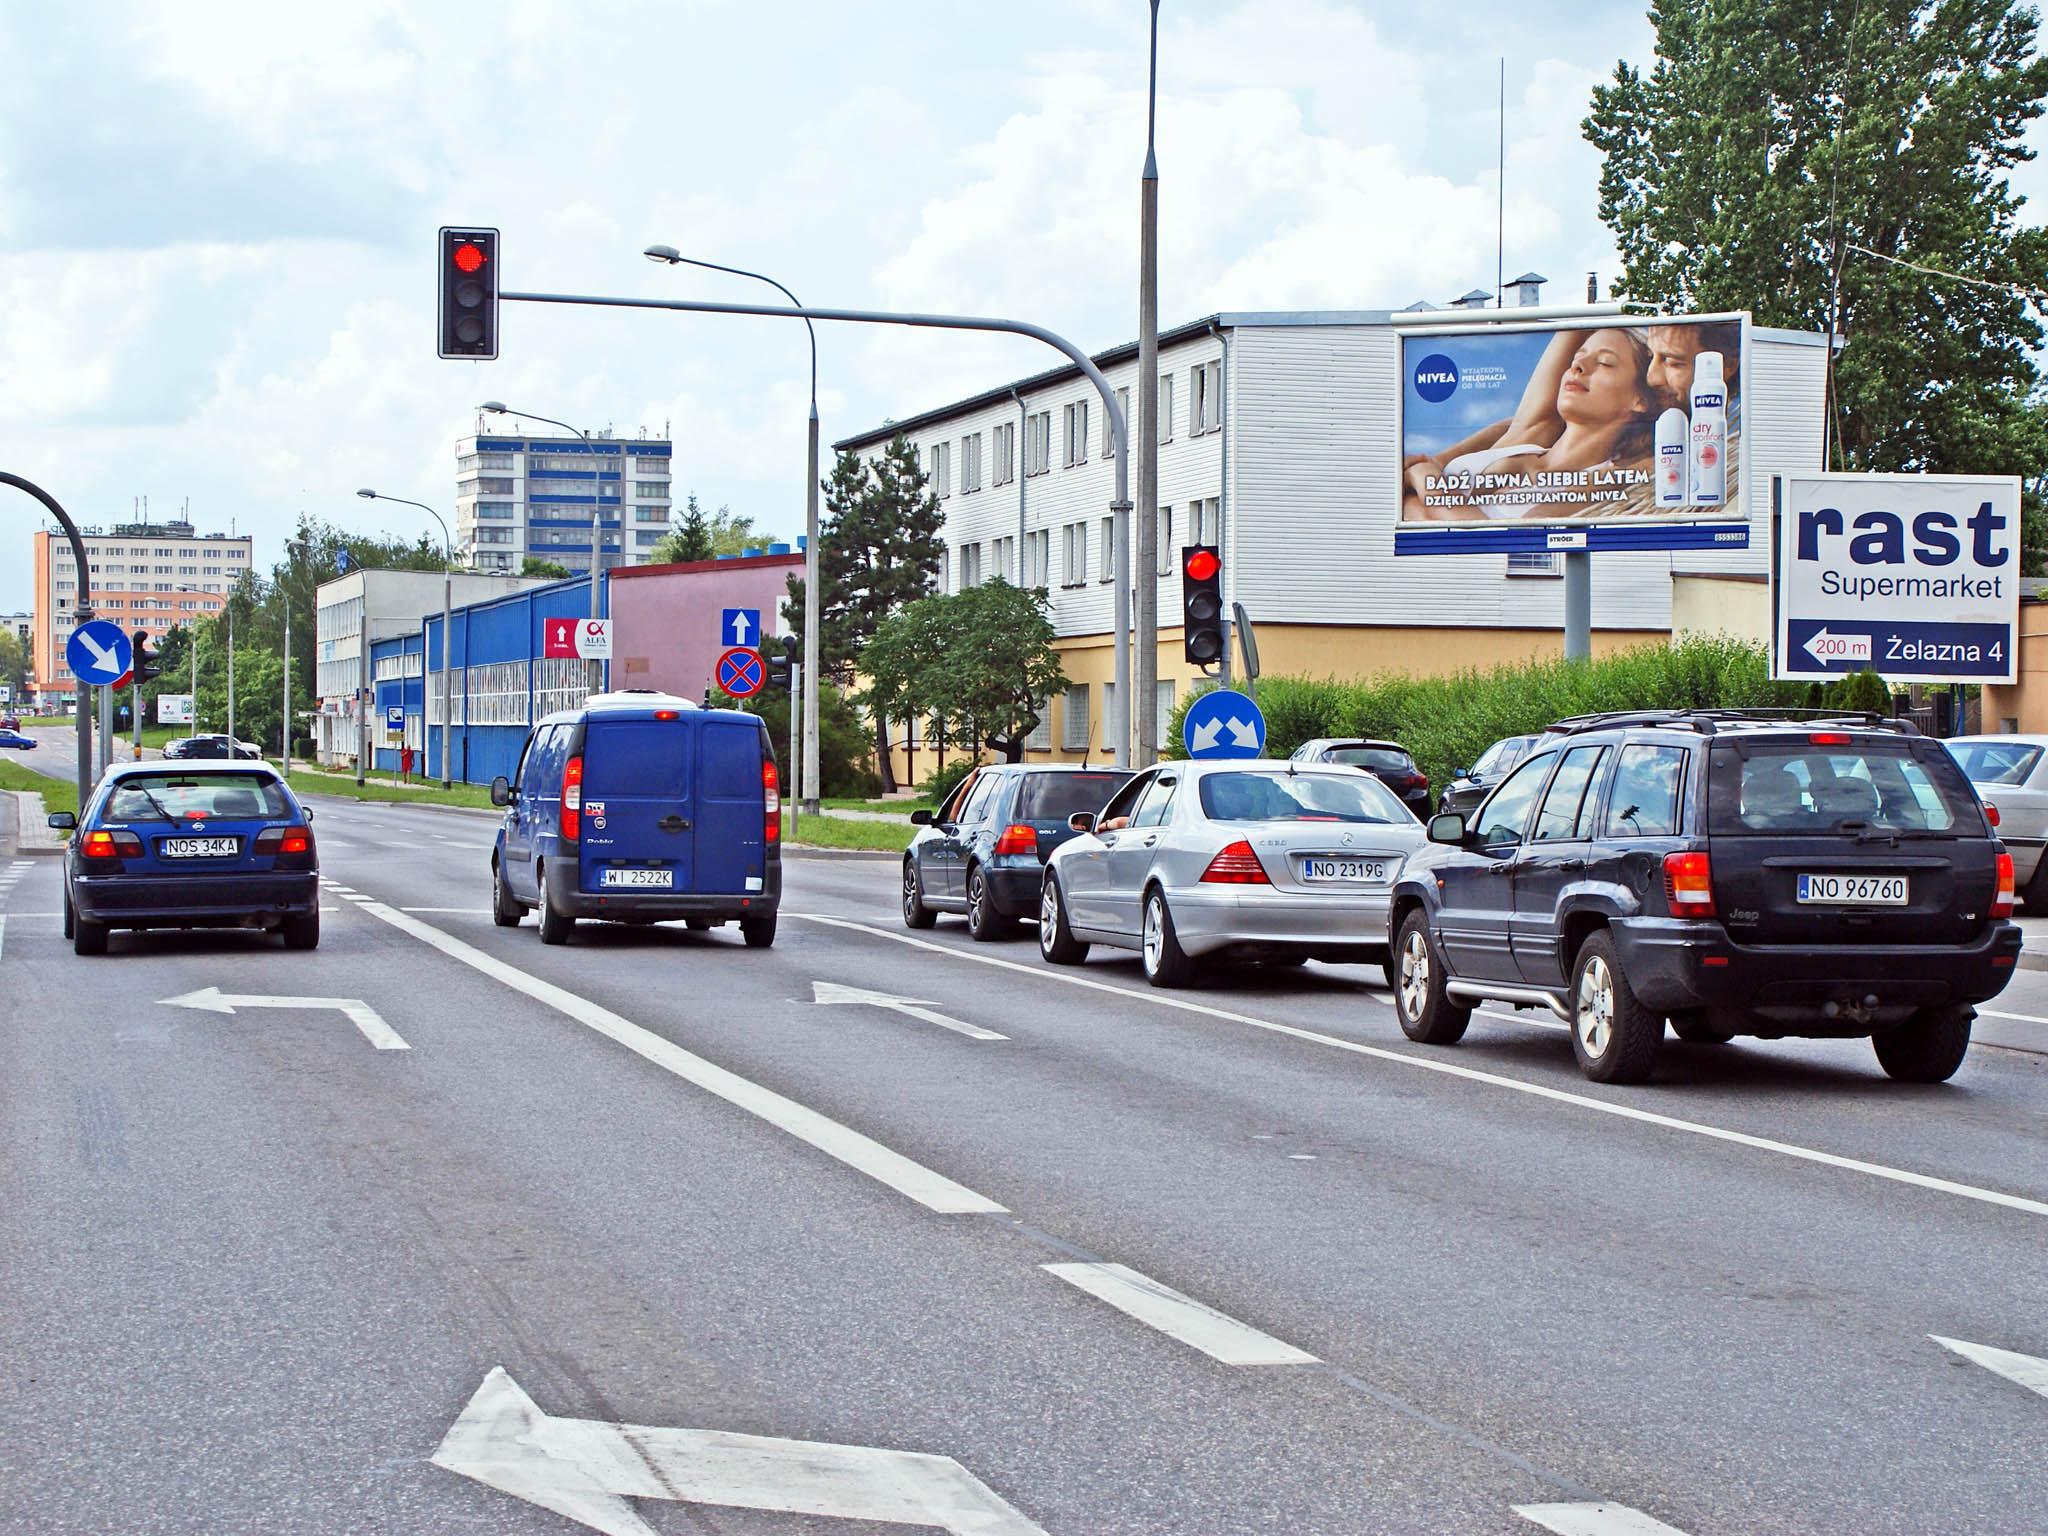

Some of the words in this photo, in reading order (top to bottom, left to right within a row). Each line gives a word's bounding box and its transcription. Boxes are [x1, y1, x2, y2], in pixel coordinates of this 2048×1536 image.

[1417, 372, 1456, 384] NIVEA
[1696, 396, 1721, 405] NIVEA
[1693, 422, 1712, 433] dry
[1425, 472, 1470, 494] BĄDŹ
[1475, 473, 1532, 489] PEWNA
[1537, 471, 1588, 487] SIEBIE
[1593, 469, 1649, 486] LATEM
[1425, 494, 1464, 508] DZIĘKI
[1467, 492, 1587, 506] ANTYPERSPIRANTOM
[1591, 490, 1629, 502] NIVEA
[1797, 501, 2009, 568] rast
[1821, 570, 2002, 602] Supermarket
[584, 636, 607, 644] ALFA
[1816, 639, 1847, 655] 200
[1852, 642, 1867, 655] m
[1885, 635, 1981, 662] Żelazna
[1988, 641, 2003, 662] 4
[168, 840, 198, 853] NOS
[202, 839, 235, 853] 34KA
[1314, 862, 1335, 877] NO
[1340, 863, 1384, 878] 2319G
[608, 871, 624, 884] WI
[631, 871, 670, 884] 2522K
[1811, 878, 1839, 898] NO
[1846, 878, 1904, 899] 96760
[1729, 907, 1760, 921] Jeep
[1958, 912, 1976, 920] V8
